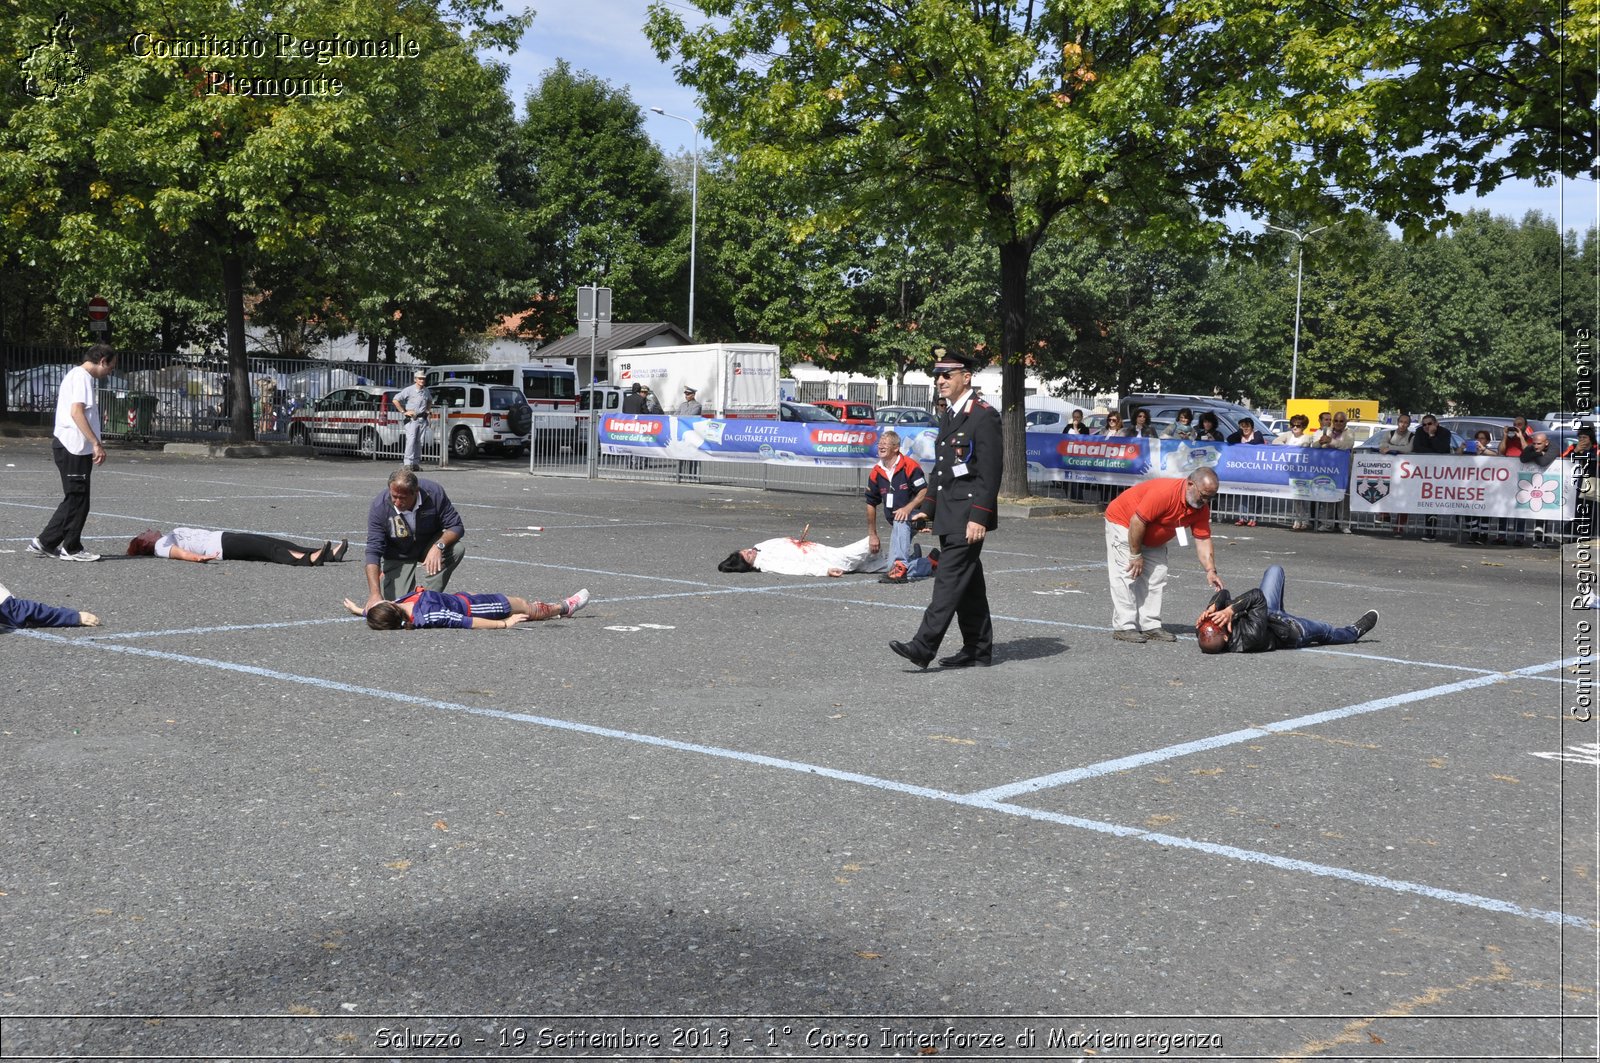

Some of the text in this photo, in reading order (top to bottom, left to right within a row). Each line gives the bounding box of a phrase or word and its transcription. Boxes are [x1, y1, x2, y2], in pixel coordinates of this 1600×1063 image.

[620, 363, 632, 371] 118
[1347, 408, 1361, 419] 118
[744, 425, 779, 435] IL LATTE
[610, 433, 629, 442] Creare
[724, 433, 798, 444] DA GUSTARE A FETTINE
[817, 444, 865, 454] Creare dal latte
[1068, 457, 1126, 469] Creare dal latte
[1255, 451, 1309, 464] IL LATTE
[1226, 461, 1261, 470] SBOCCIA
[1275, 464, 1295, 472] FIOR
[1297, 465, 1307, 473] DI
[1309, 466, 1340, 475] PANNA
[1363, 467, 1384, 475] BENESE
[1400, 461, 1510, 482] SALUMIFICIO
[1421, 482, 1485, 501] BENESE
[1435, 501, 1471, 510] VAGIENNA
[1471, 502, 1487, 511] (CN)
